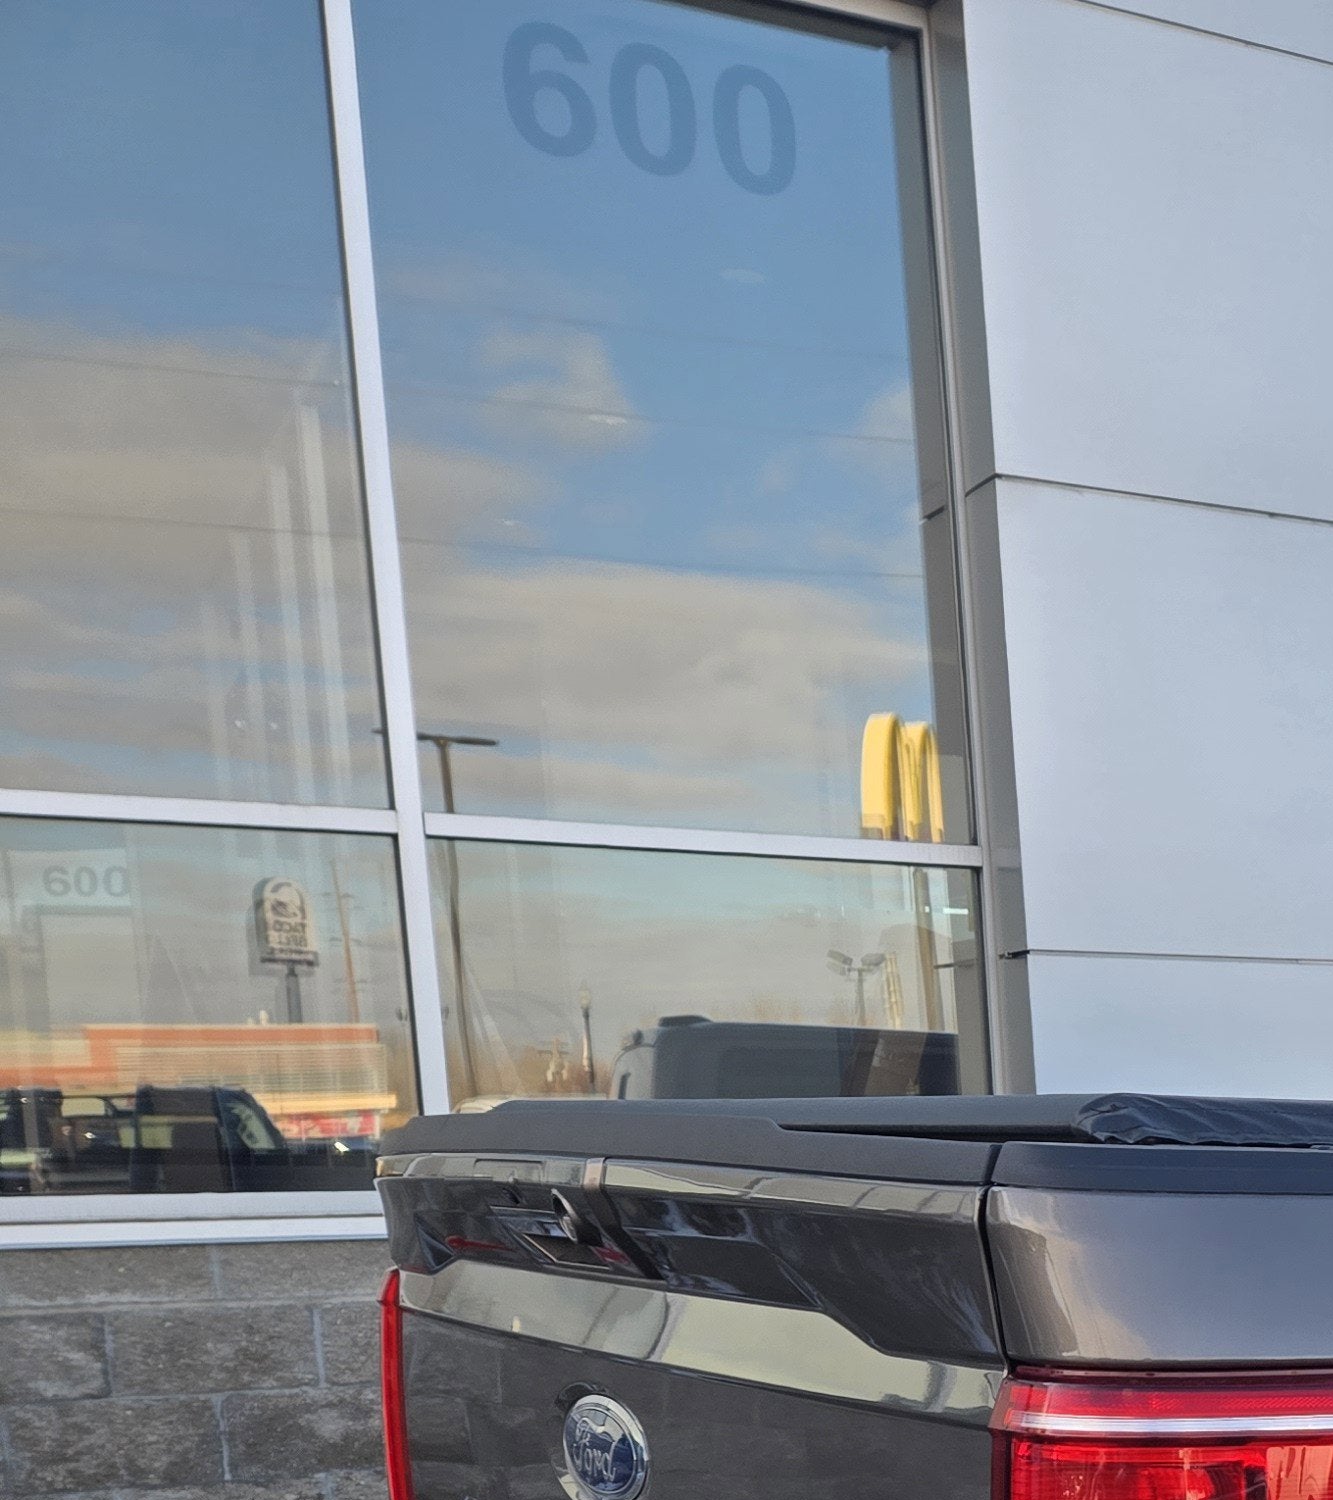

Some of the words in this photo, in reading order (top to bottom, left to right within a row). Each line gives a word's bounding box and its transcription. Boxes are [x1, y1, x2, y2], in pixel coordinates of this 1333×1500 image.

[502, 20, 797, 197] 600
[43, 864, 131, 898] 600
[572, 1416, 618, 1482] Ford
